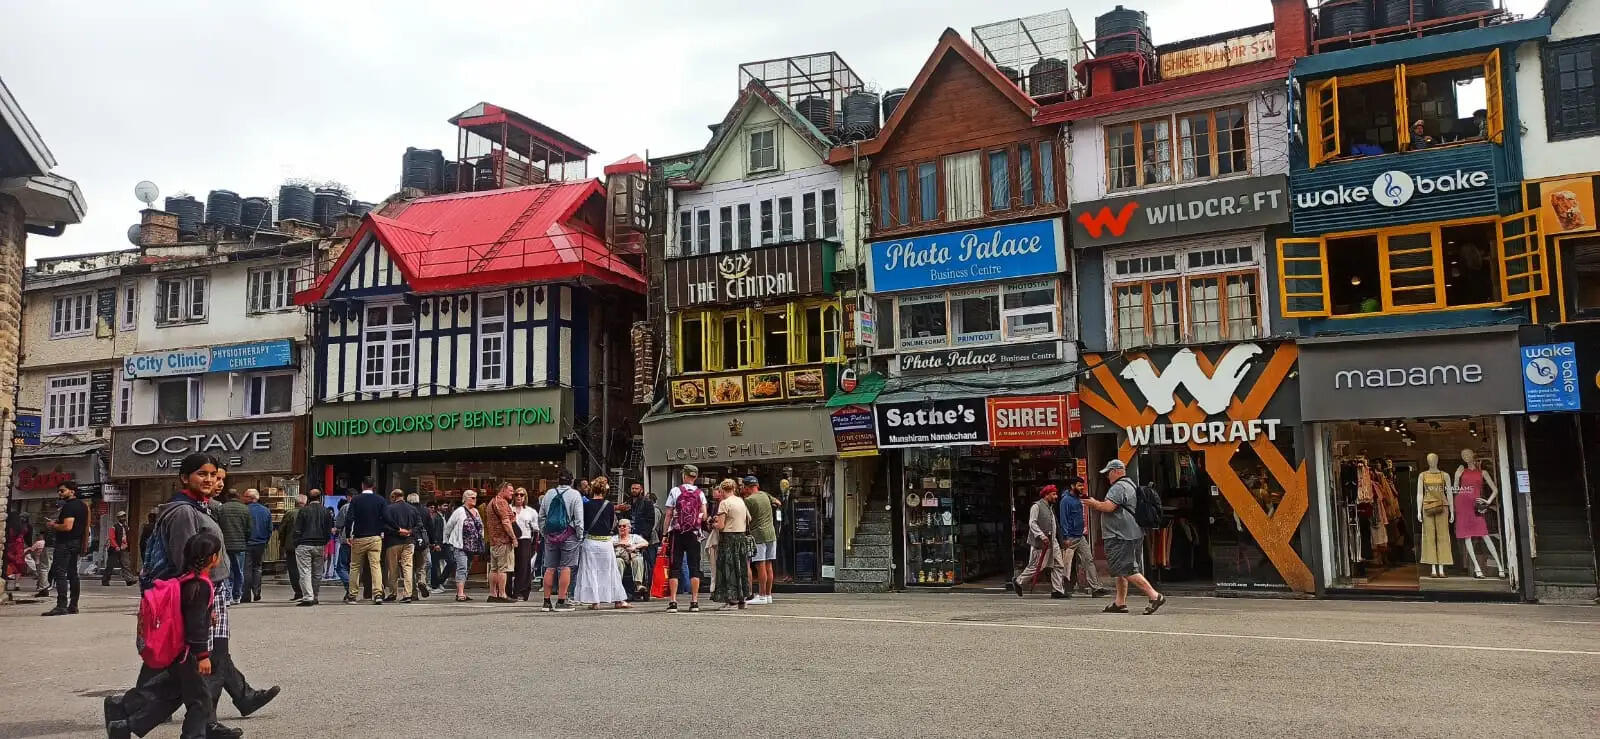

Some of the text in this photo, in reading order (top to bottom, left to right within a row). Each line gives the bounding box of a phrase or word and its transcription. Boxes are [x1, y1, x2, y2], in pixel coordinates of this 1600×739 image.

[1297, 169, 1489, 209] wake bake
[885, 230, 1042, 271] Photo Palace
[930, 263, 1002, 281] Business Centre
[689, 271, 797, 303] THE CENTRAL
[1007, 280, 1049, 291] PHOTOSTAT
[902, 338, 946, 347] ONLINE FORMS
[957, 333, 994, 343] PRINTOUT
[136, 351, 208, 374] City Clinic
[212, 345, 270, 359] PHYSIOTHERAPY
[229, 356, 257, 369] CENTRE
[902, 351, 1056, 371] Photo Palace Business Centre
[1525, 345, 1573, 359] wake
[1561, 360, 1575, 393] bake
[314, 418, 369, 439] UNITED
[372, 414, 434, 434] COLORS
[437, 412, 460, 430] OF
[887, 404, 976, 427] Sathe's
[996, 406, 1059, 428] SHREE
[131, 431, 272, 455] OCTAVE
[889, 431, 978, 444] Munshiram Nanakchand
[1126, 418, 1280, 447] WILDCRAFT
[666, 439, 814, 462] LOUIS PHILIPPE
